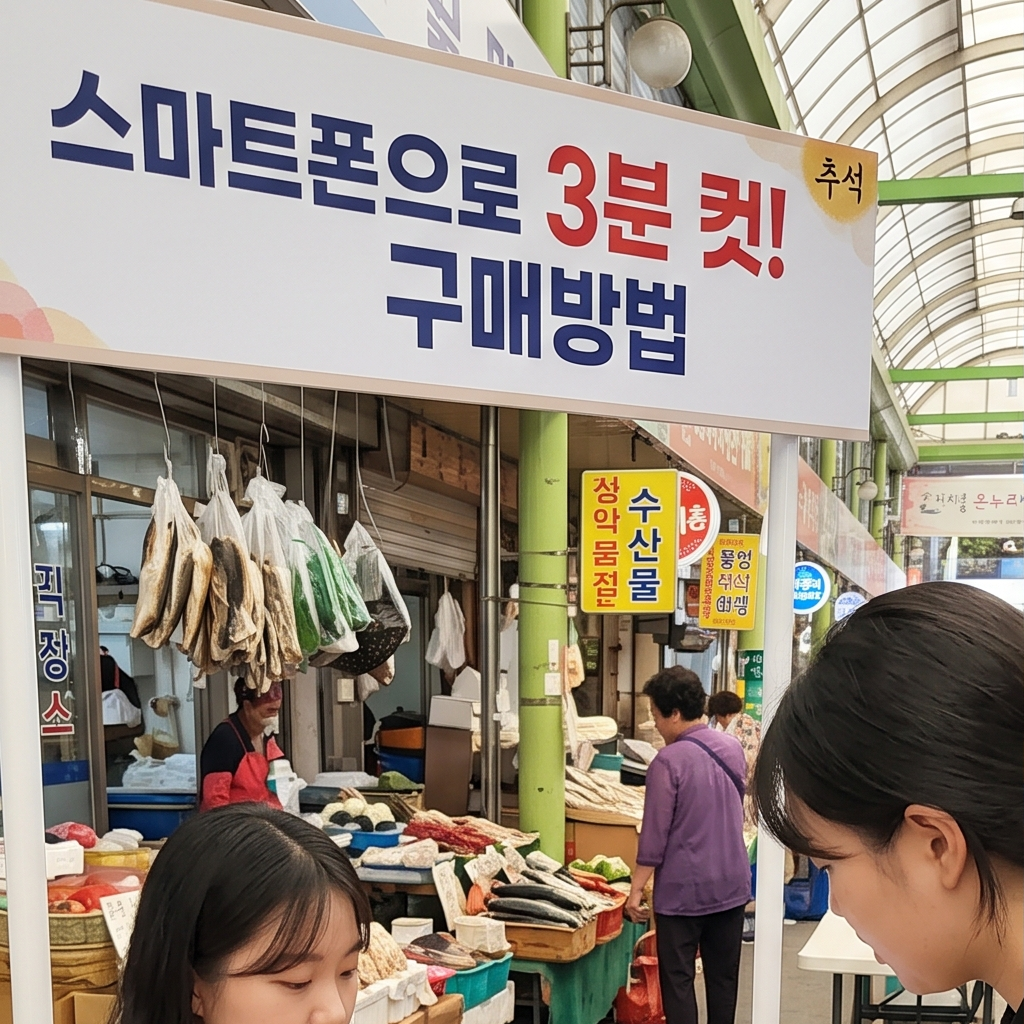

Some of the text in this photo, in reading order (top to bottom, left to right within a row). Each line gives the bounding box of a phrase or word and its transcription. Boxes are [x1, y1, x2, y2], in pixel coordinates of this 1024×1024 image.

[50, 69, 786, 280] 스마트폰으로 3분 컷!
[813, 156, 864, 206] 추석
[386, 242, 687, 377] 구매방법
[627, 487, 663, 603] 수산물
